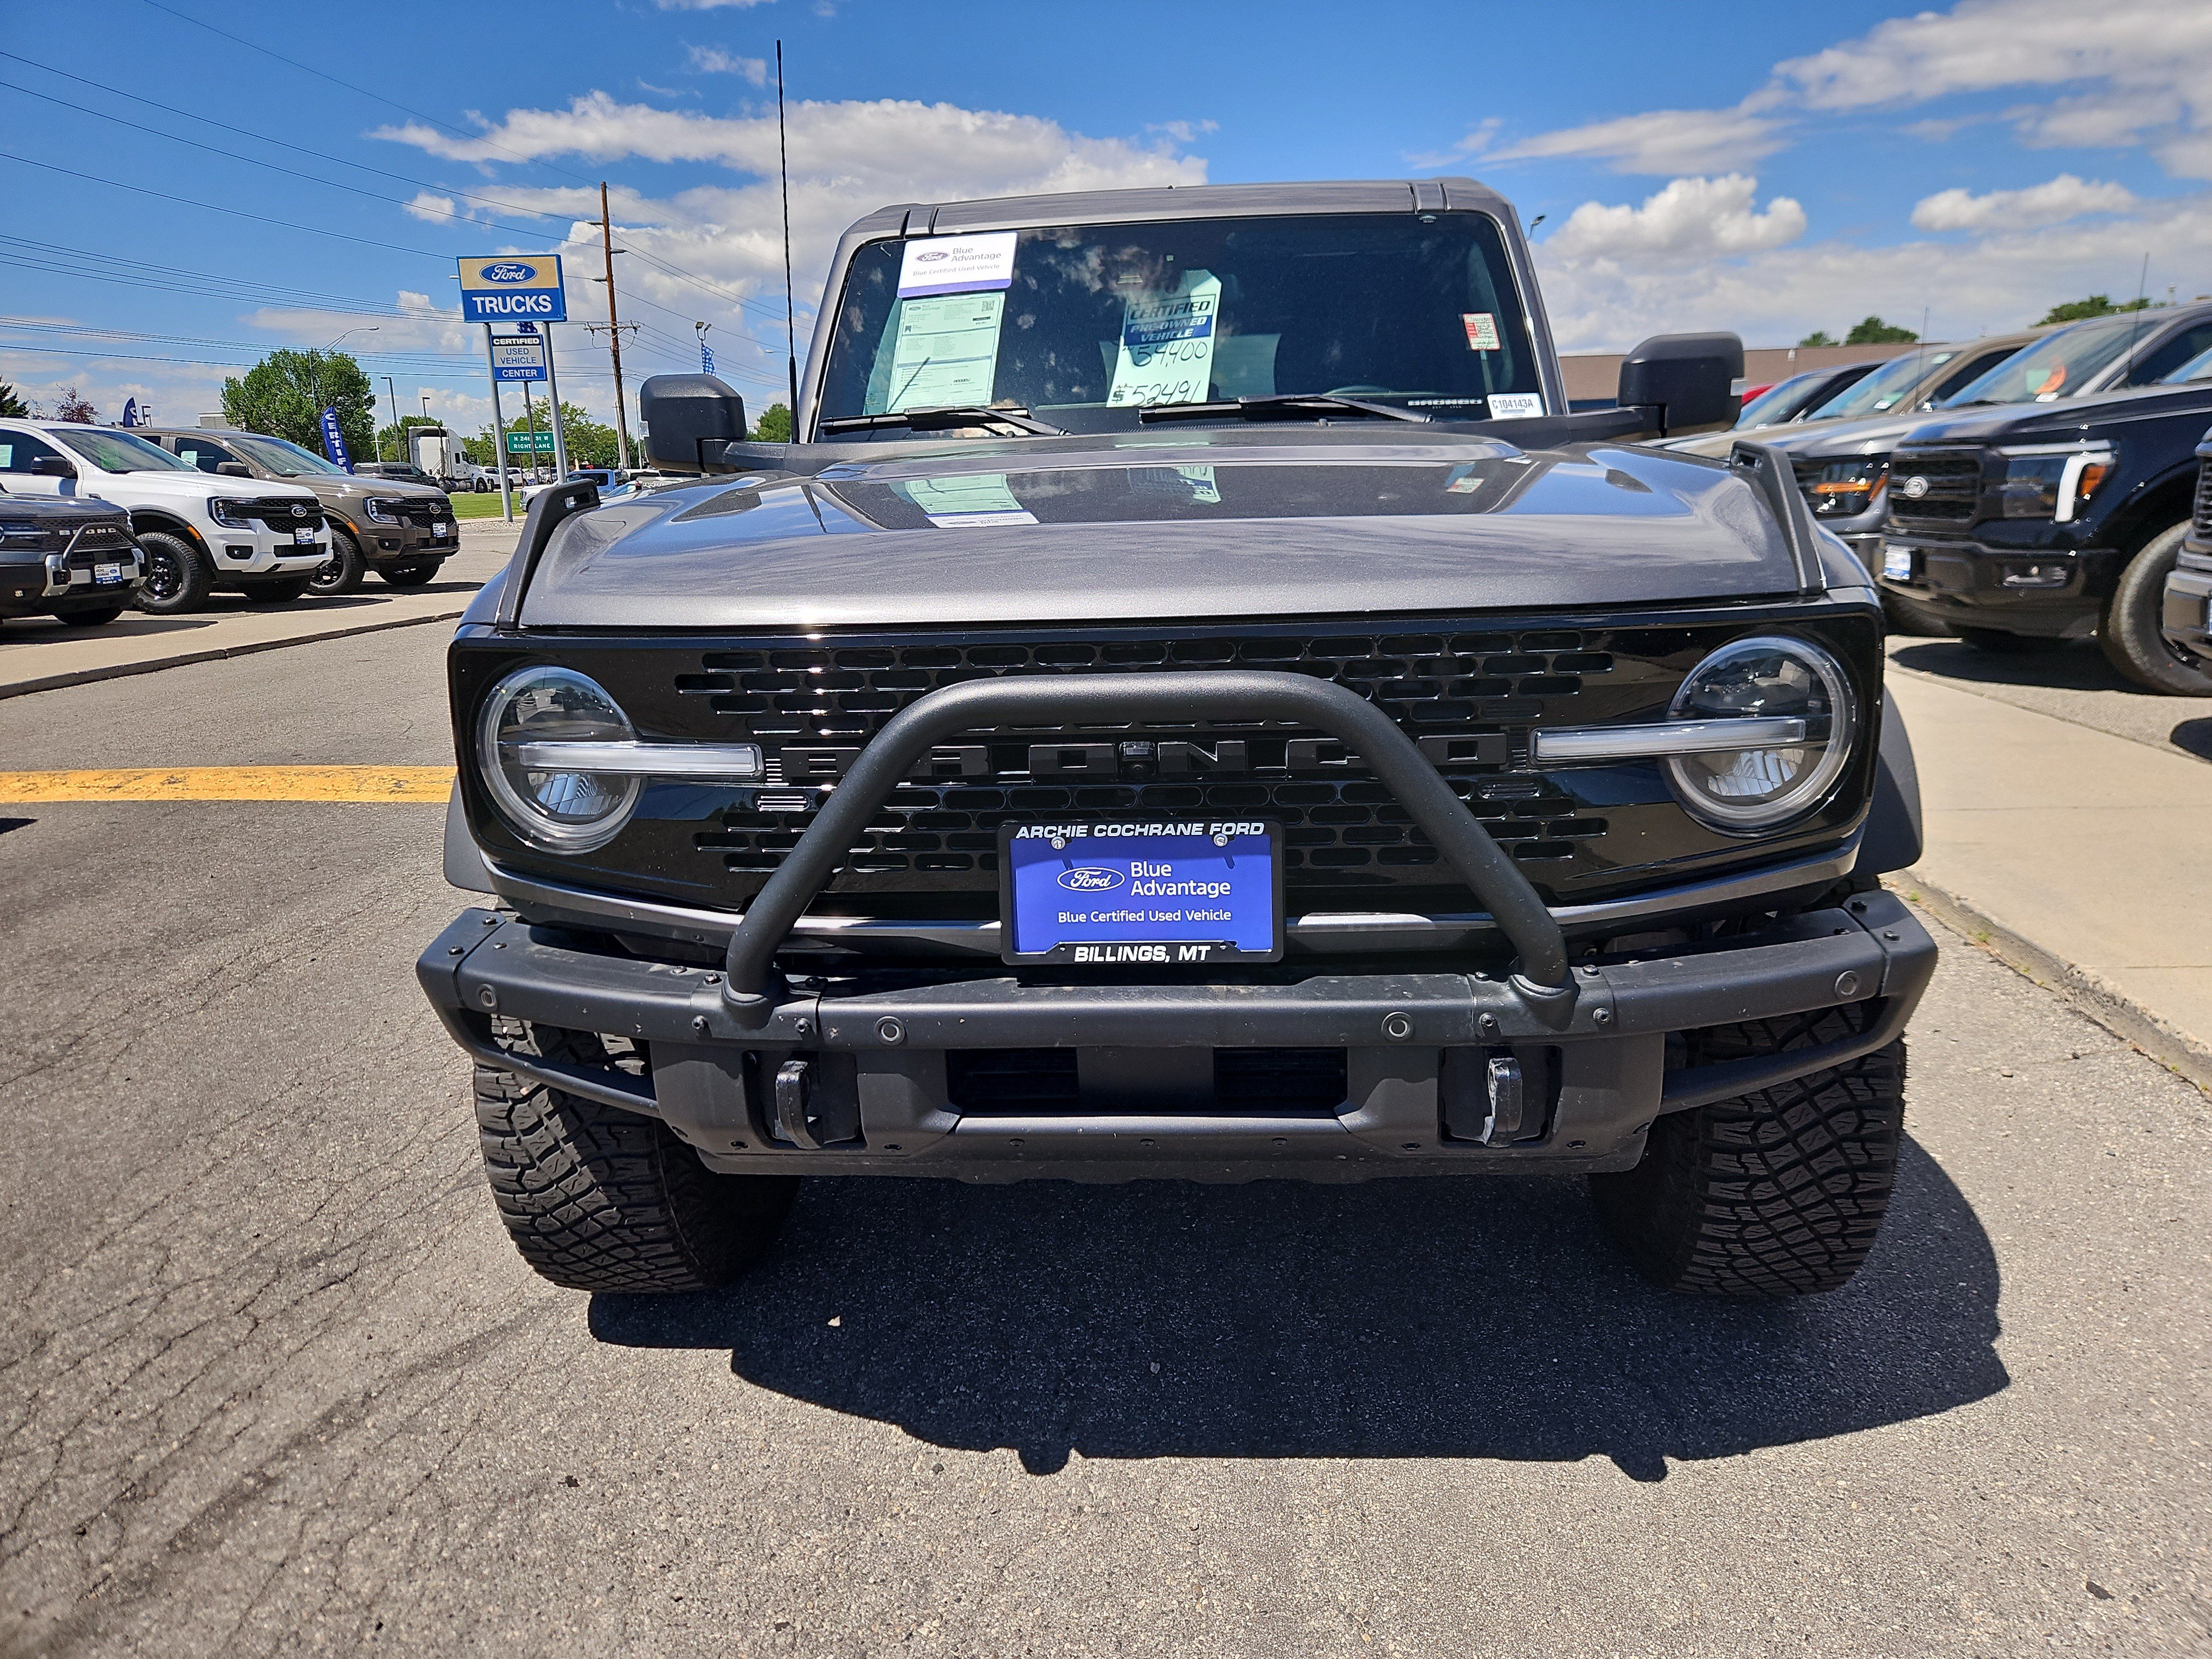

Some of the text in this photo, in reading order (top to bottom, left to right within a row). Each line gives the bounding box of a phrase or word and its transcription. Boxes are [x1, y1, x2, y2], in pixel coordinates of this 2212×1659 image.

[922, 252, 1001, 262] Ford Advantage
[491, 265, 526, 280] Ford
[472, 295, 552, 313] TRUCKS
[1130, 300, 1211, 320] CERTIFIED
[1130, 317, 1208, 333] PRE-OWNED
[493, 337, 540, 345] CERTIFIED
[1140, 328, 1194, 342] VEHICLE
[499, 356, 537, 364] VEHICLE
[501, 369, 537, 377] CENTER
[1491, 399, 1534, 409] C104143A
[1015, 822, 1264, 839] ARCHIE COCHRANE FORD
[1130, 861, 1172, 877] Blue
[1069, 870, 1231, 898] Ford Advantage
[1058, 908, 1232, 923] Blue Certified Used Vehicle
[1073, 945, 1212, 963] BILLINGS, MT
